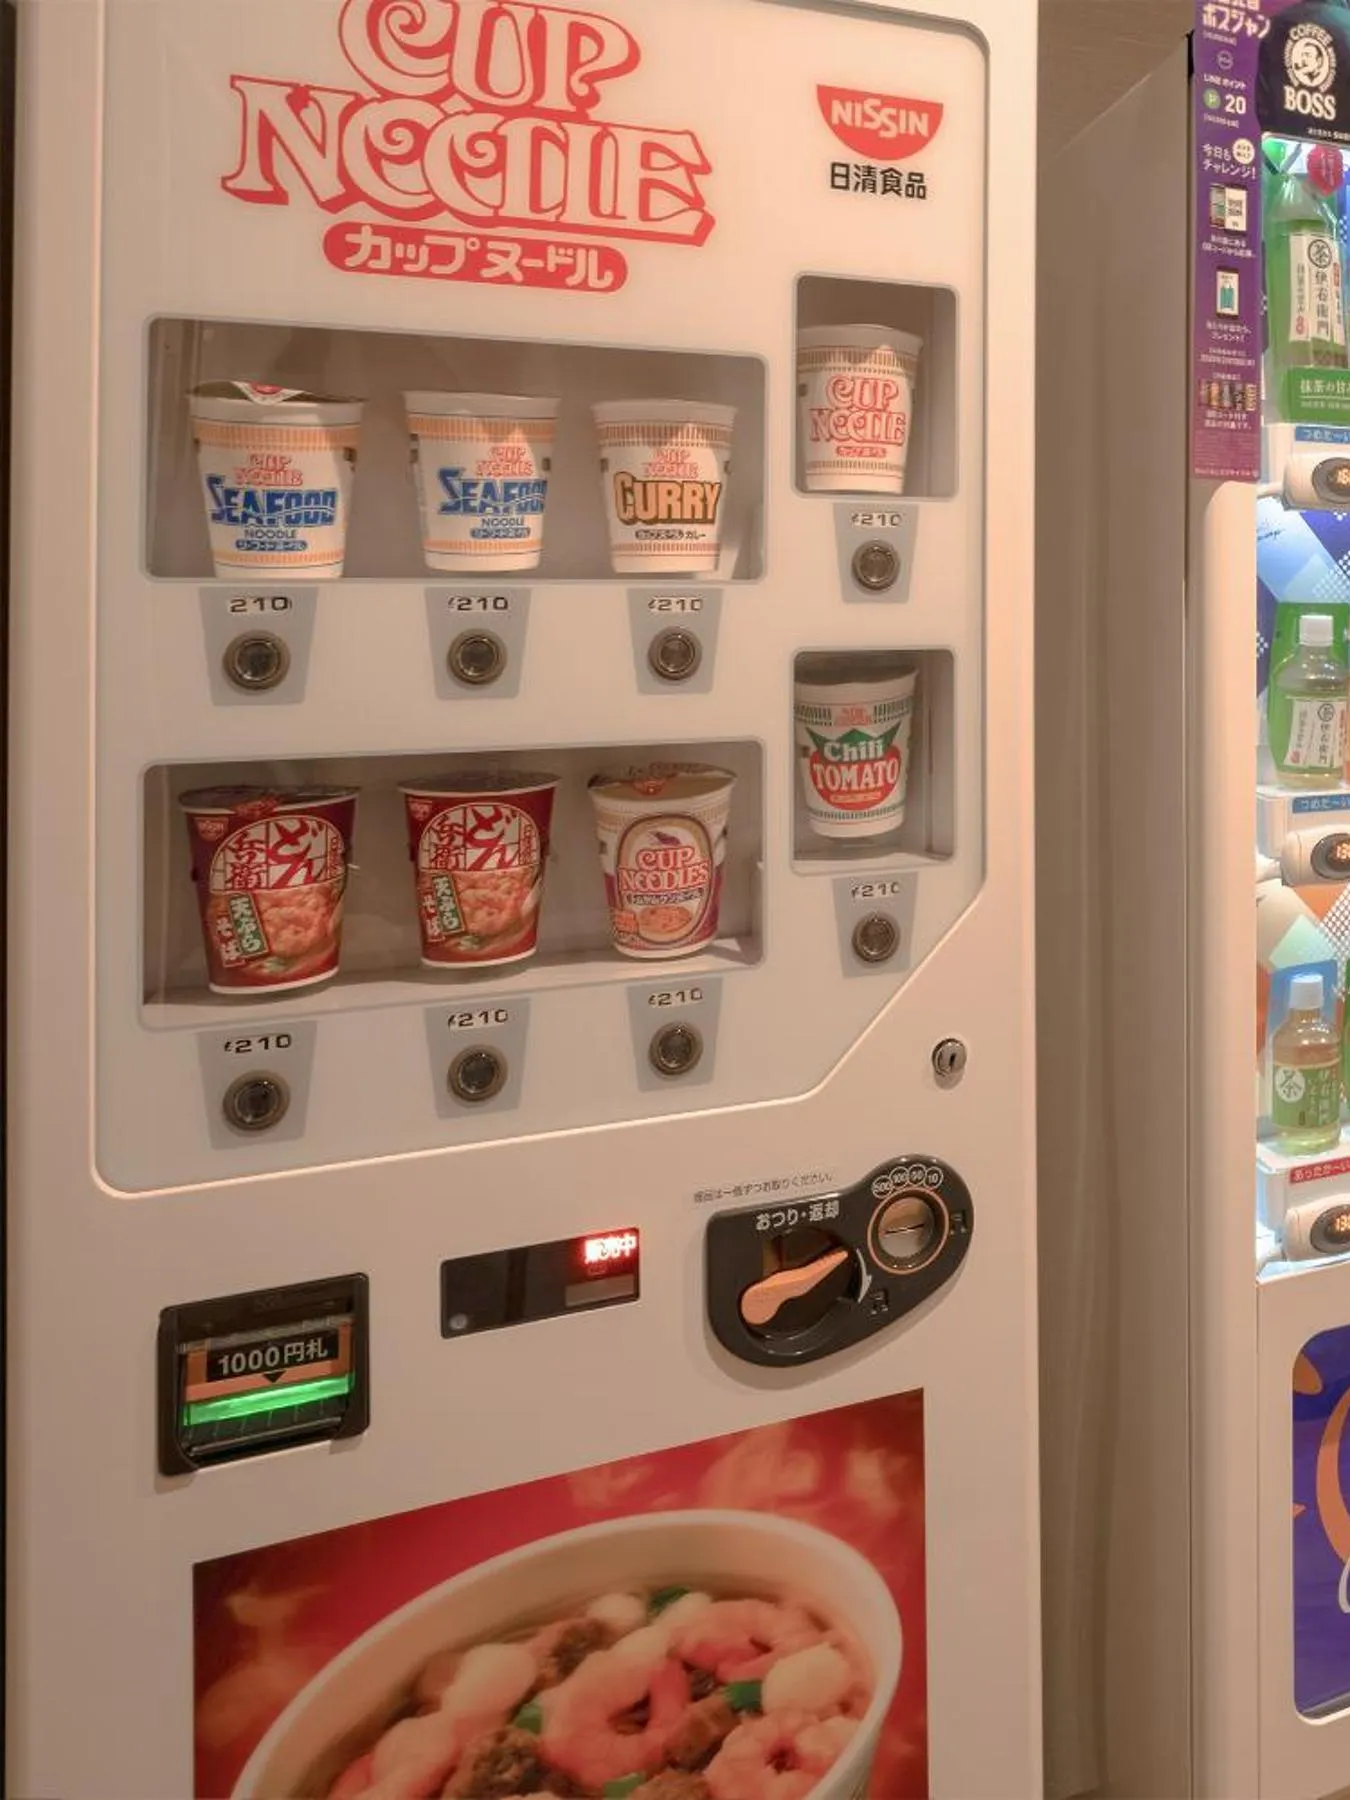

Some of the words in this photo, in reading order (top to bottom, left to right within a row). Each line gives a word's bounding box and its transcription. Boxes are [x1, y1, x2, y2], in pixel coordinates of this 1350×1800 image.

[1289, 22, 1333, 46] COFFEE
[338, 0, 641, 112] CUP
[831, 98, 931, 139] NISSIN
[1224, 94, 1247, 115] 20
[1283, 84, 1337, 121] BOSS
[221, 74, 716, 246] NOODLE
[829, 161, 928, 200] 日清食品
[344, 228, 615, 289] カップヌードル
[826, 374, 900, 411] CUP
[809, 408, 906, 446] NOODLE
[206, 474, 338, 527] SEAFOOD
[614, 471, 722, 525] CURRY
[244, 528, 298, 540] NOODLE
[823, 739, 885, 762] Chili
[813, 757, 899, 792] TOMATO
[618, 860, 711, 893] NOODLES
[637, 847, 695, 870] CUP
[755, 1200, 840, 1231] おつり・返却
[218, 1337, 328, 1377] 1000円札
